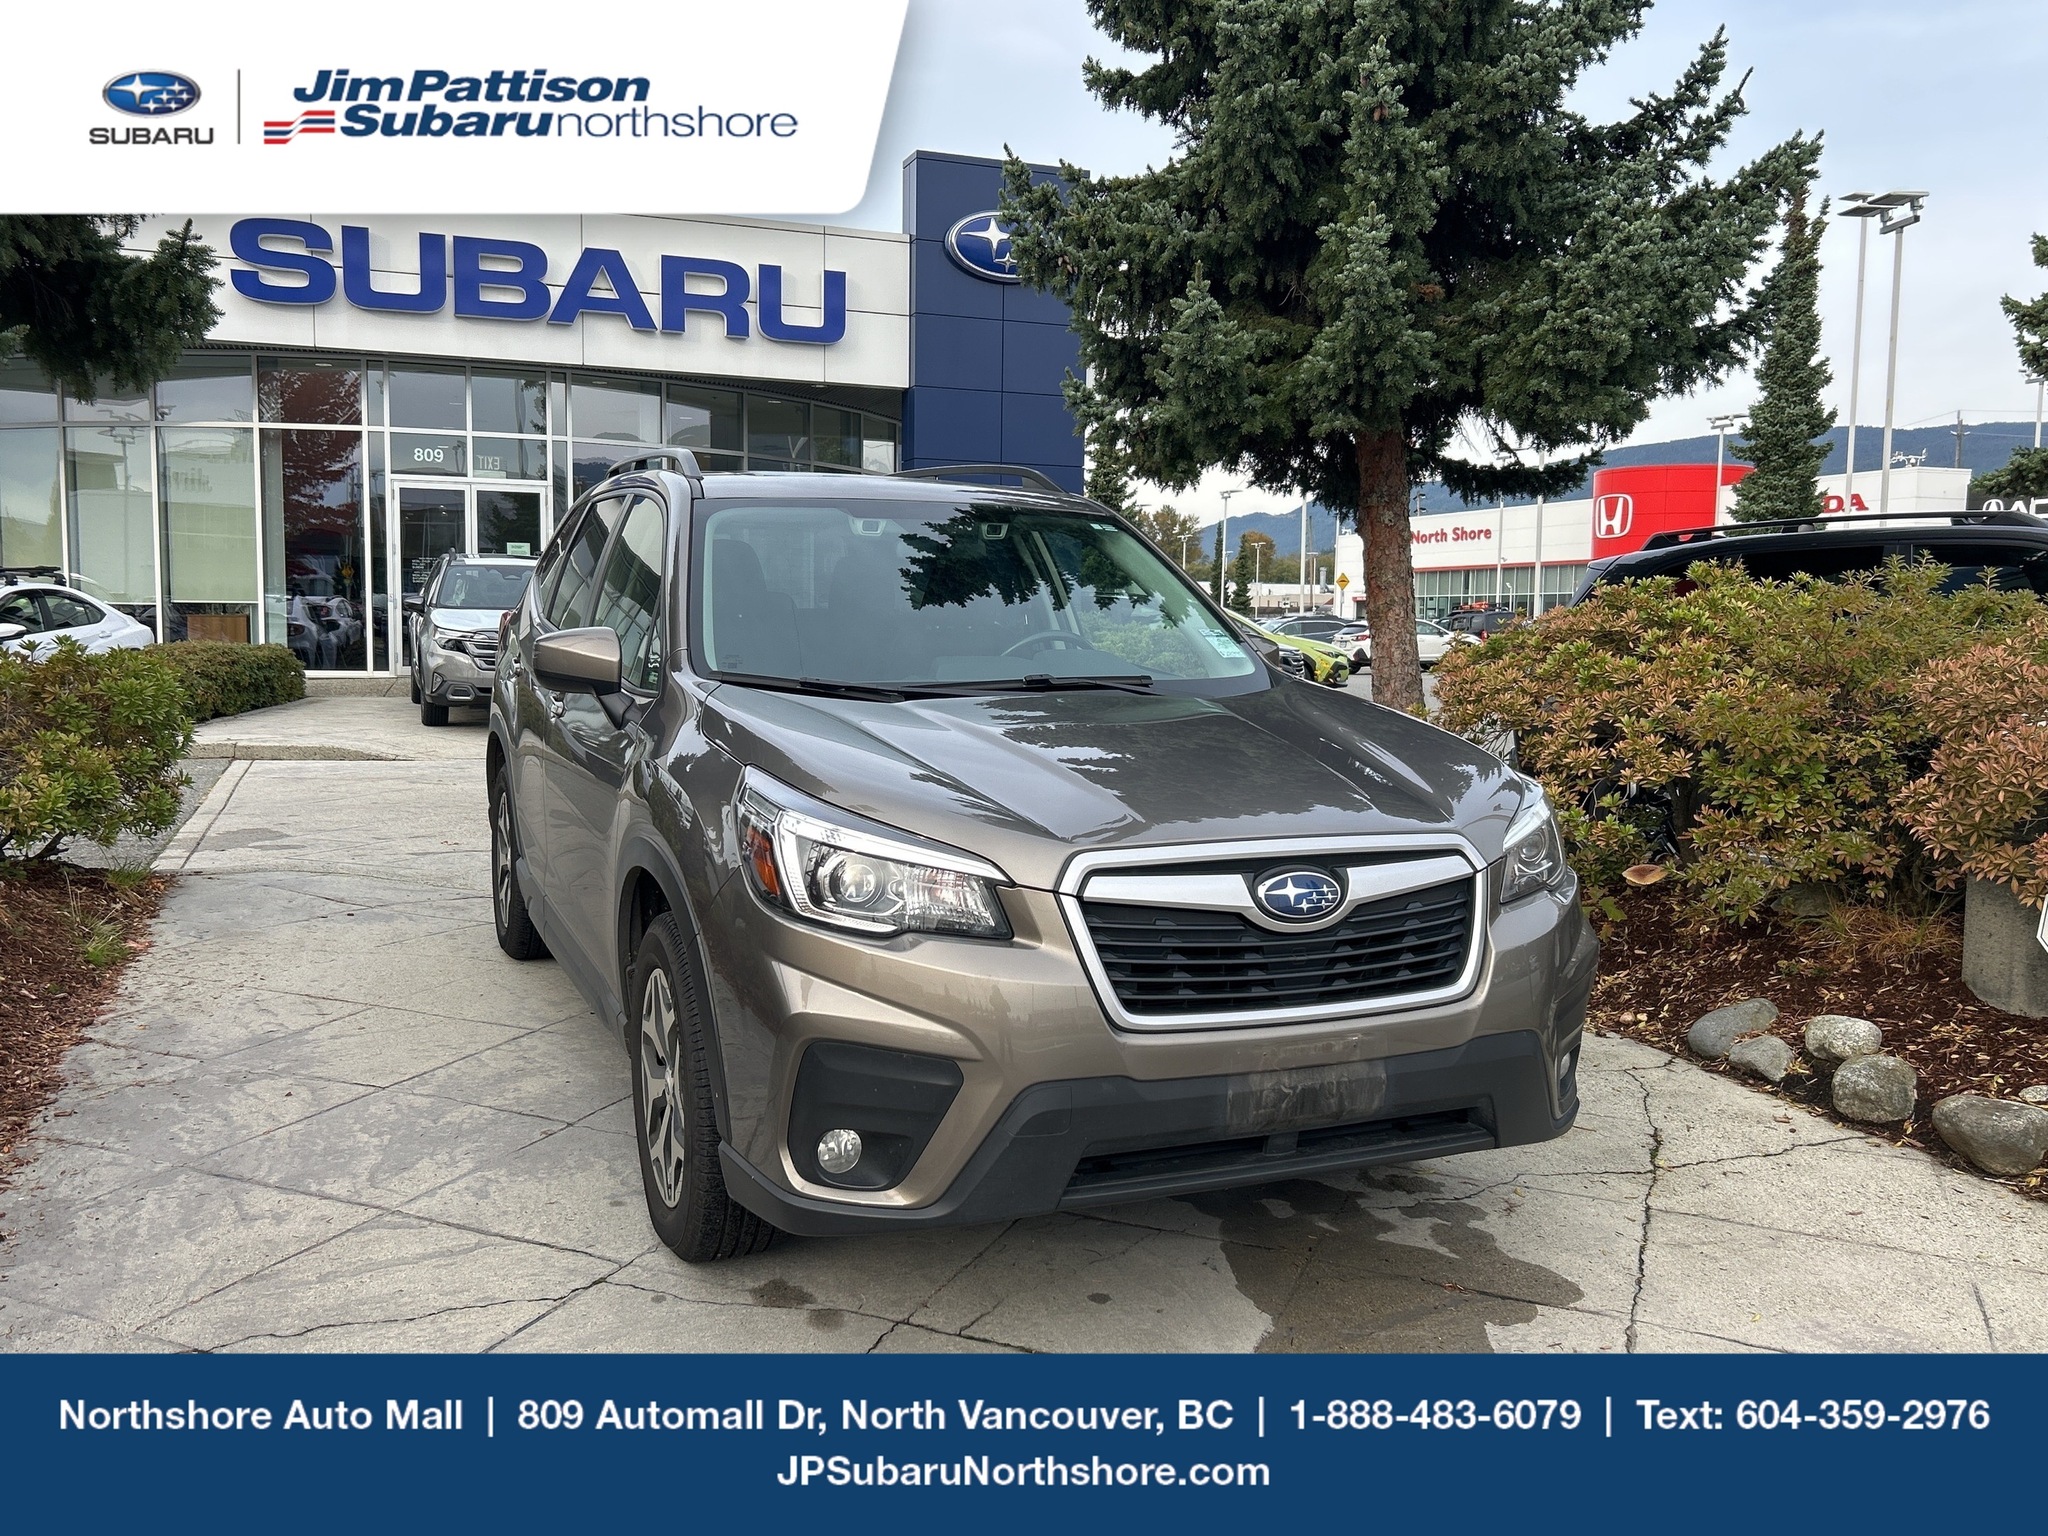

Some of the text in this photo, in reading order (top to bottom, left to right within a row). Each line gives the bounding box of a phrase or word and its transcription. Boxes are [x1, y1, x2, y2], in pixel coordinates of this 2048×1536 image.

[229, 217, 848, 346] SUBARU
[413, 448, 444, 463] 809
[1410, 526, 1493, 544] North Shore
